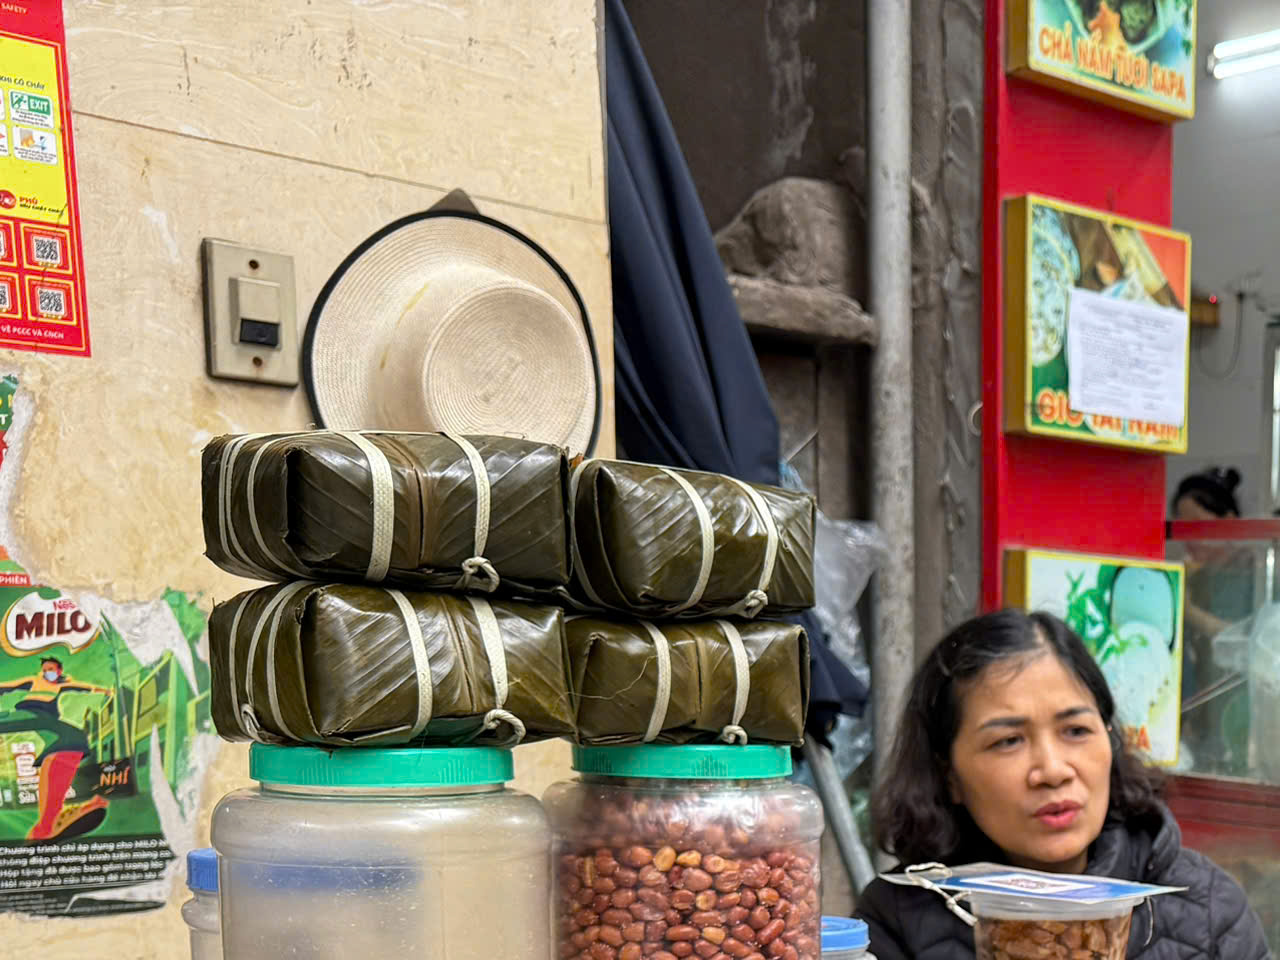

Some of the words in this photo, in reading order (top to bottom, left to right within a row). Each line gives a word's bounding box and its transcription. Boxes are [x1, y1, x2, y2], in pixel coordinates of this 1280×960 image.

[1039, 21, 1073, 63] CHẢ
[1152, 62, 1187, 102] SAPA
[30, 98, 49, 113] EXIT
[15, 610, 92, 641] MILO
